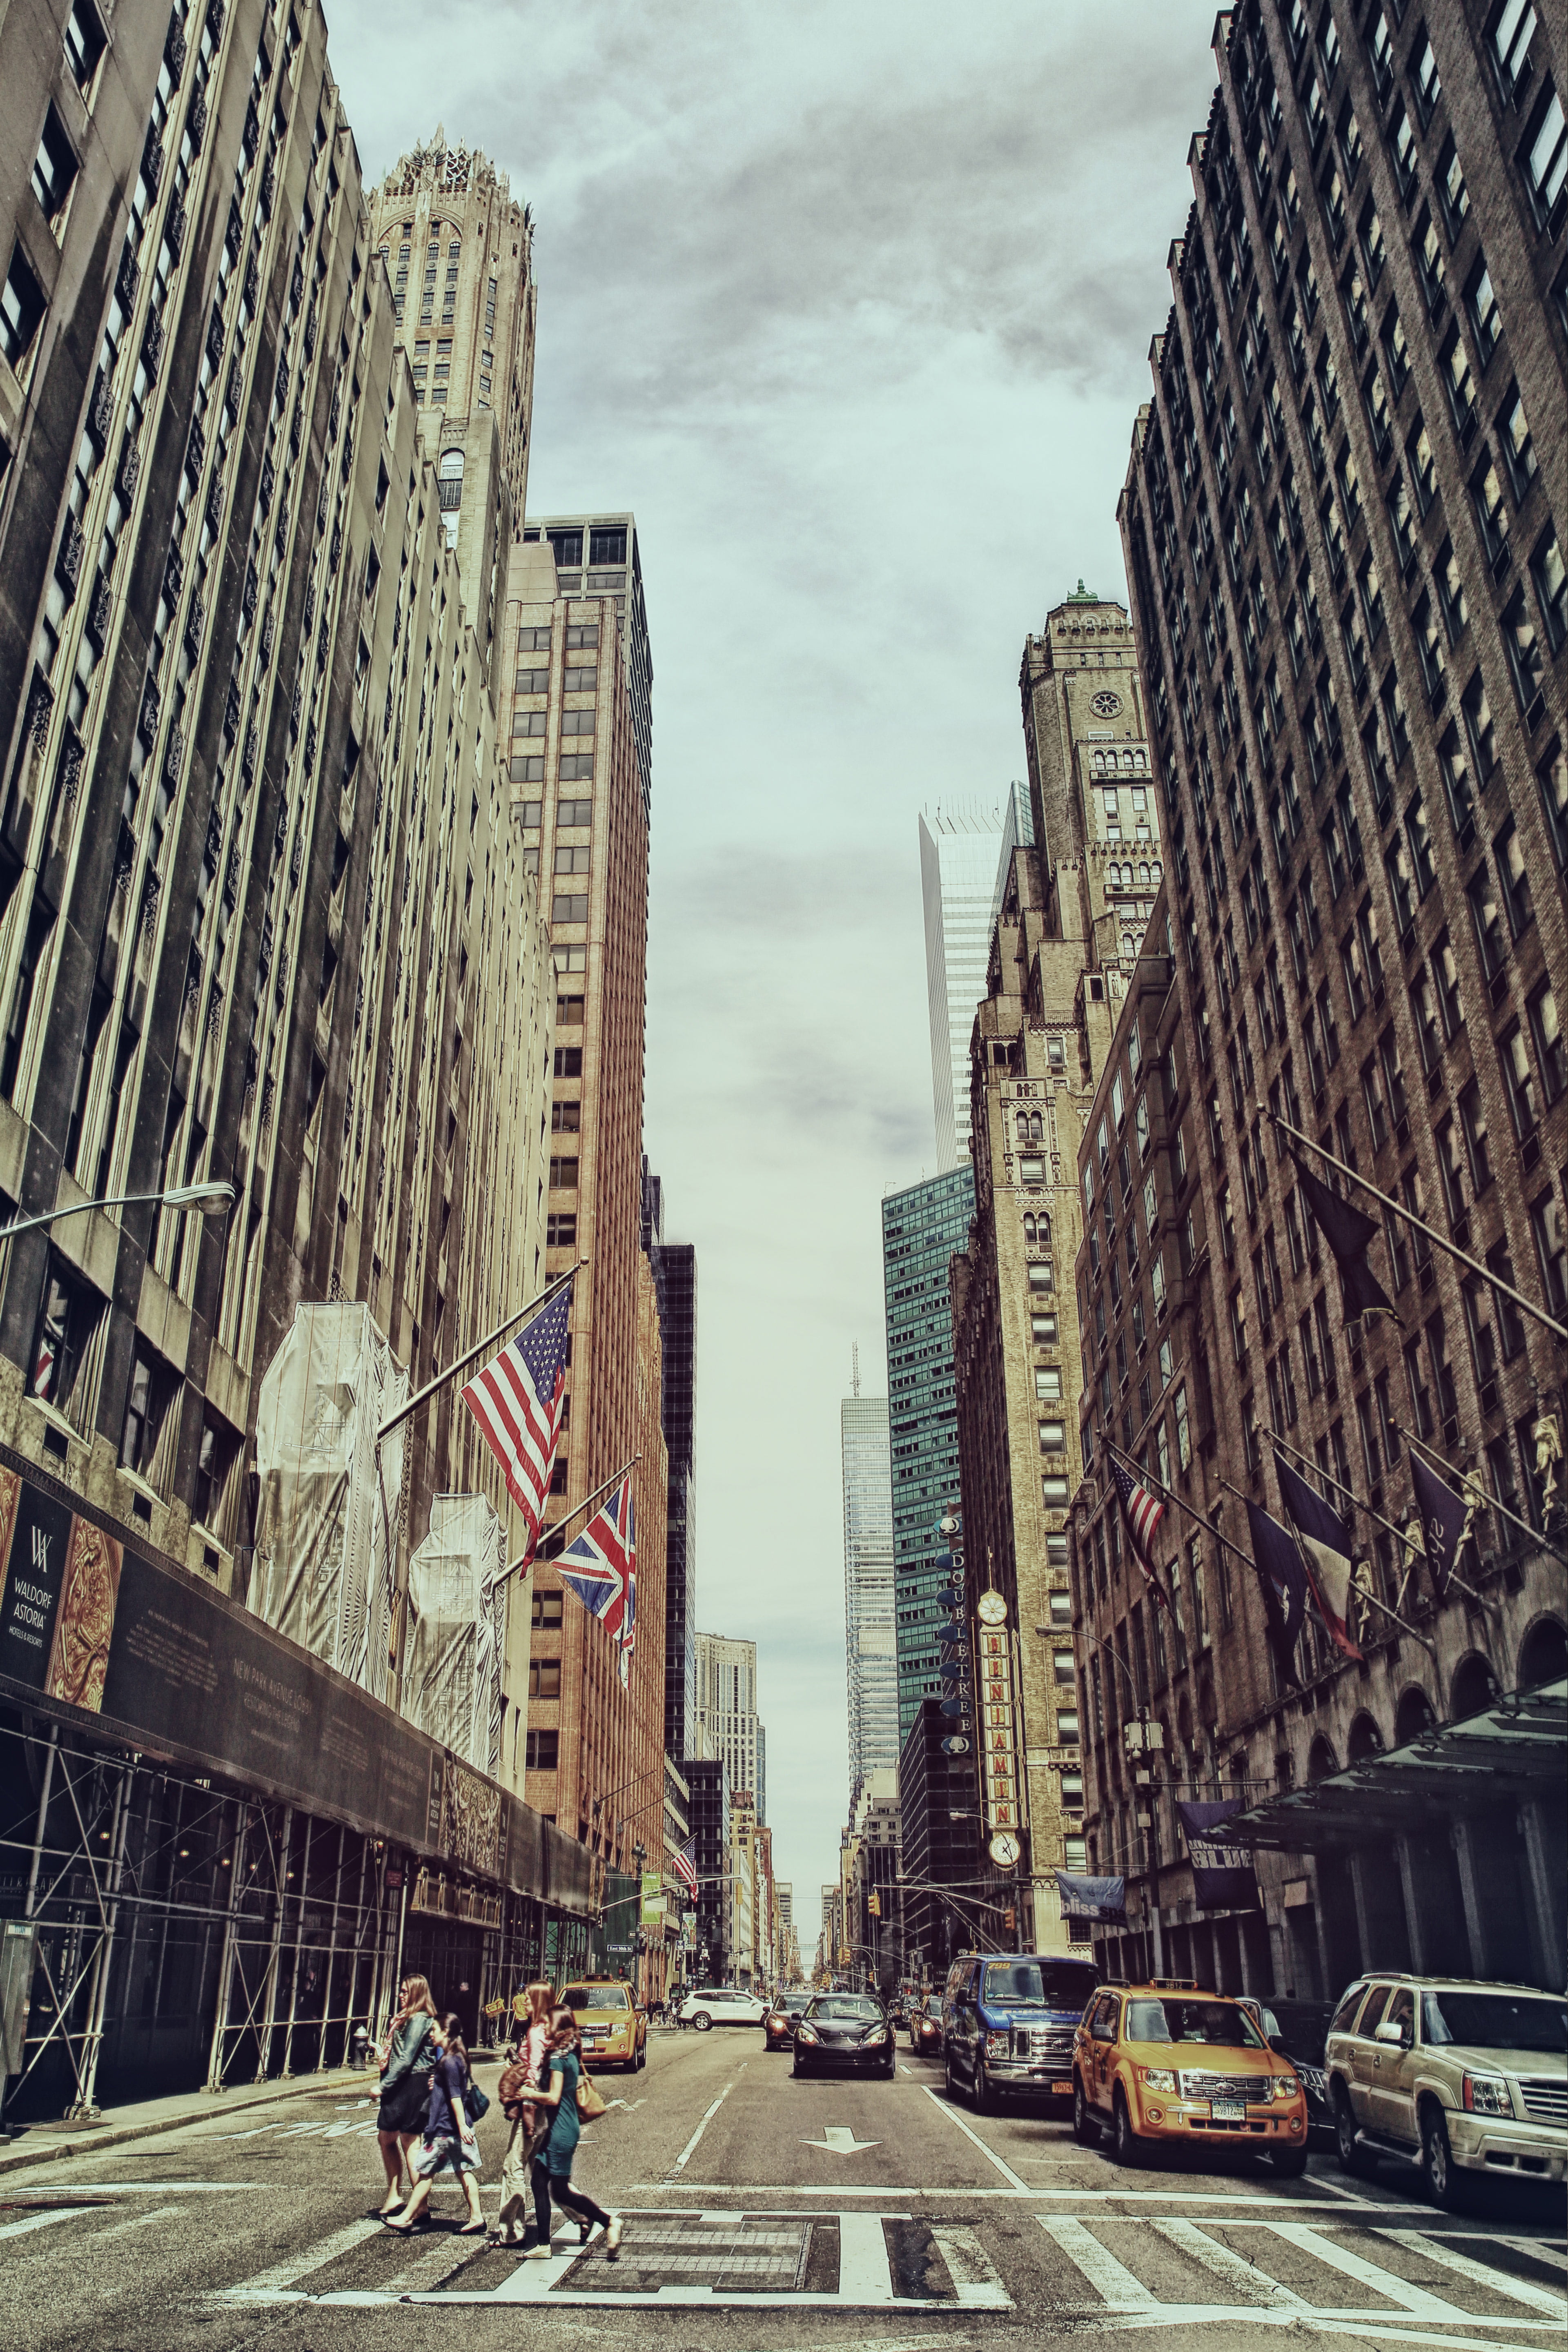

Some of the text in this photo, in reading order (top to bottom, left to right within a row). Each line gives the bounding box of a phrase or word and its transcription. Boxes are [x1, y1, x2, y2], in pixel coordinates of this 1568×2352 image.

[15, 1577, 52, 1609] WALDORF
[13, 1603, 45, 1630] ASTORIA
[9, 1626, 43, 1648] HOTELS & RESORTS
[951, 1555, 971, 1731] DOUBLETREE
[234, 1658, 251, 1681] NEW
[251, 1668, 267, 1692] PARK
[269, 1679, 293, 1706] AVENUE
[991, 1637, 1008, 1822] BENJAMIN
[1191, 1849, 1252, 1869] BLUE
[1061, 1898, 1126, 1922] bliss spa
[988, 1962, 1011, 1970] 799
[1165, 1981, 1183, 1989] 9B12
